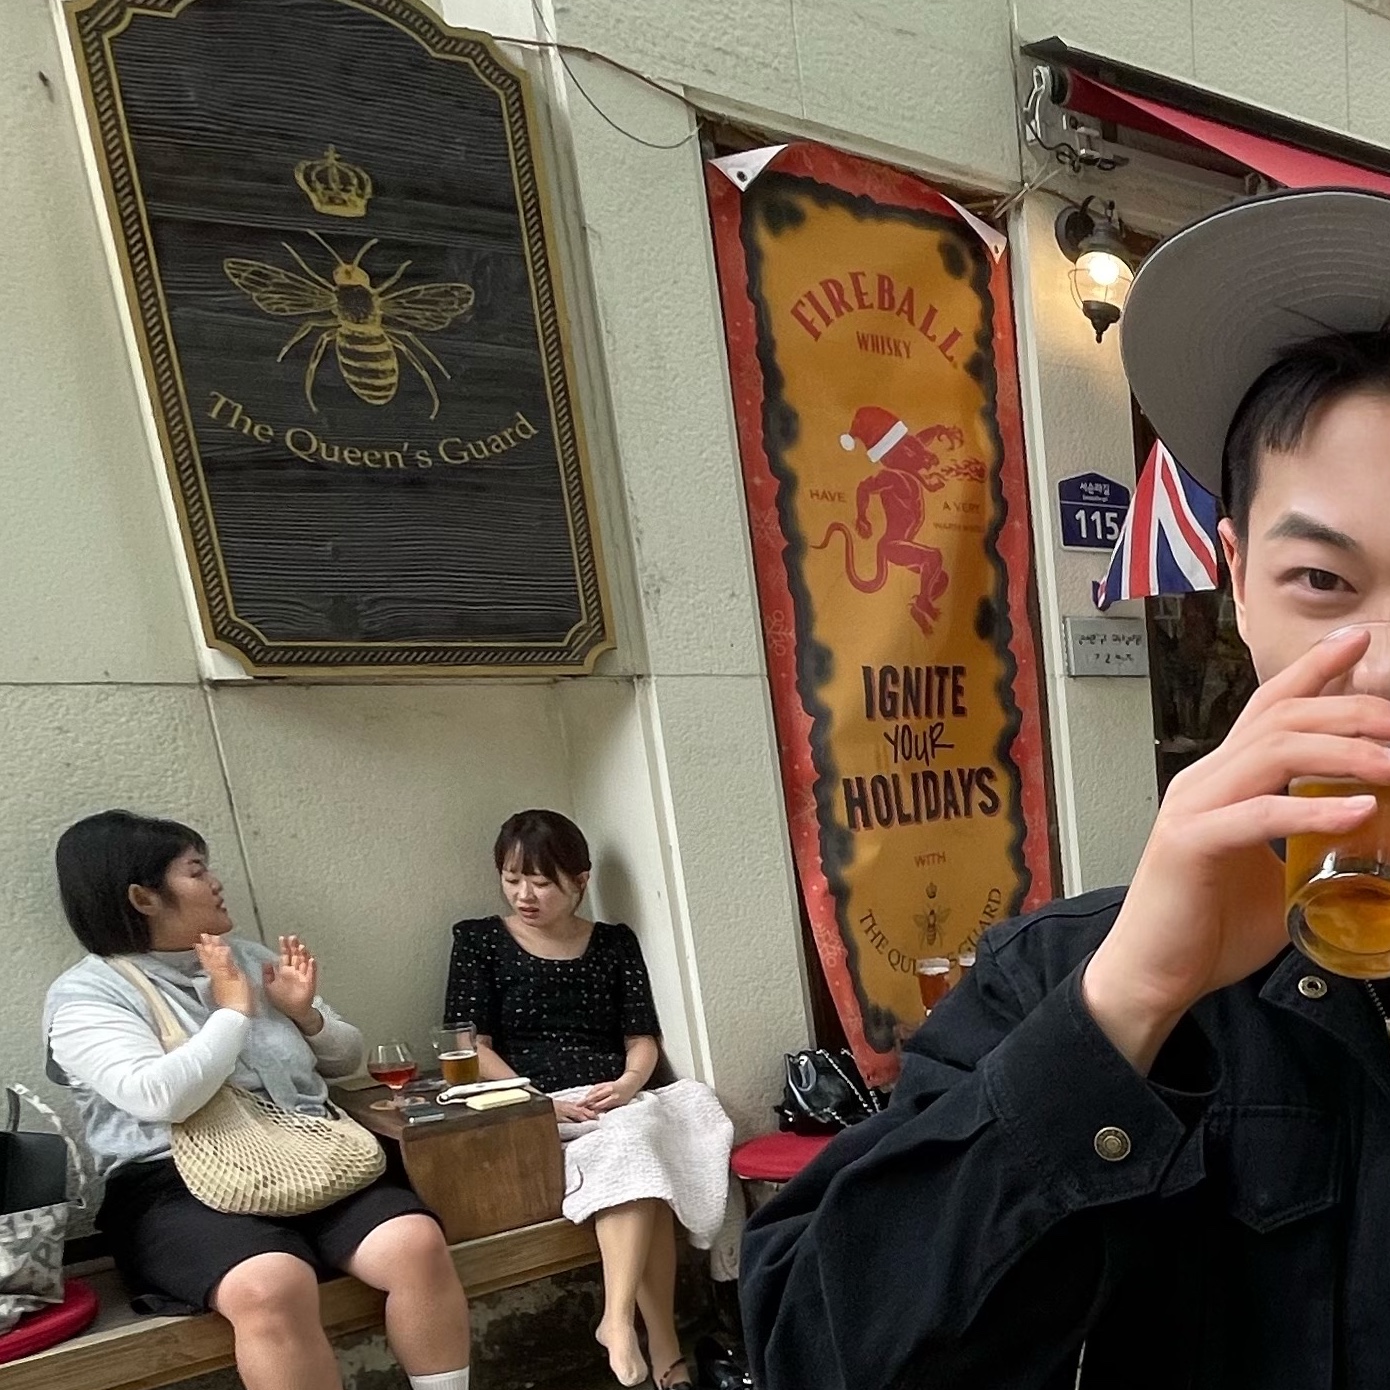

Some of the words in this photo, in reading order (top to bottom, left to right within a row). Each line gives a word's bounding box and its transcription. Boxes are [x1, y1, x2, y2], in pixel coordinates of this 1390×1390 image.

[790, 271, 963, 363] FIREBALL
[856, 331, 911, 359] WHISKY
[207, 391, 274, 443] The
[285, 427, 433, 469] Queen's
[438, 412, 539, 465] Guard
[809, 489, 847, 503] HAVE
[1075, 509, 1119, 541] 115
[862, 665, 968, 721] IGNITE
[883, 722, 954, 767] YOUR
[842, 766, 1001, 832] HOLIDAYS
[914, 851, 946, 868] WITH
[859, 908, 889, 955] THE
